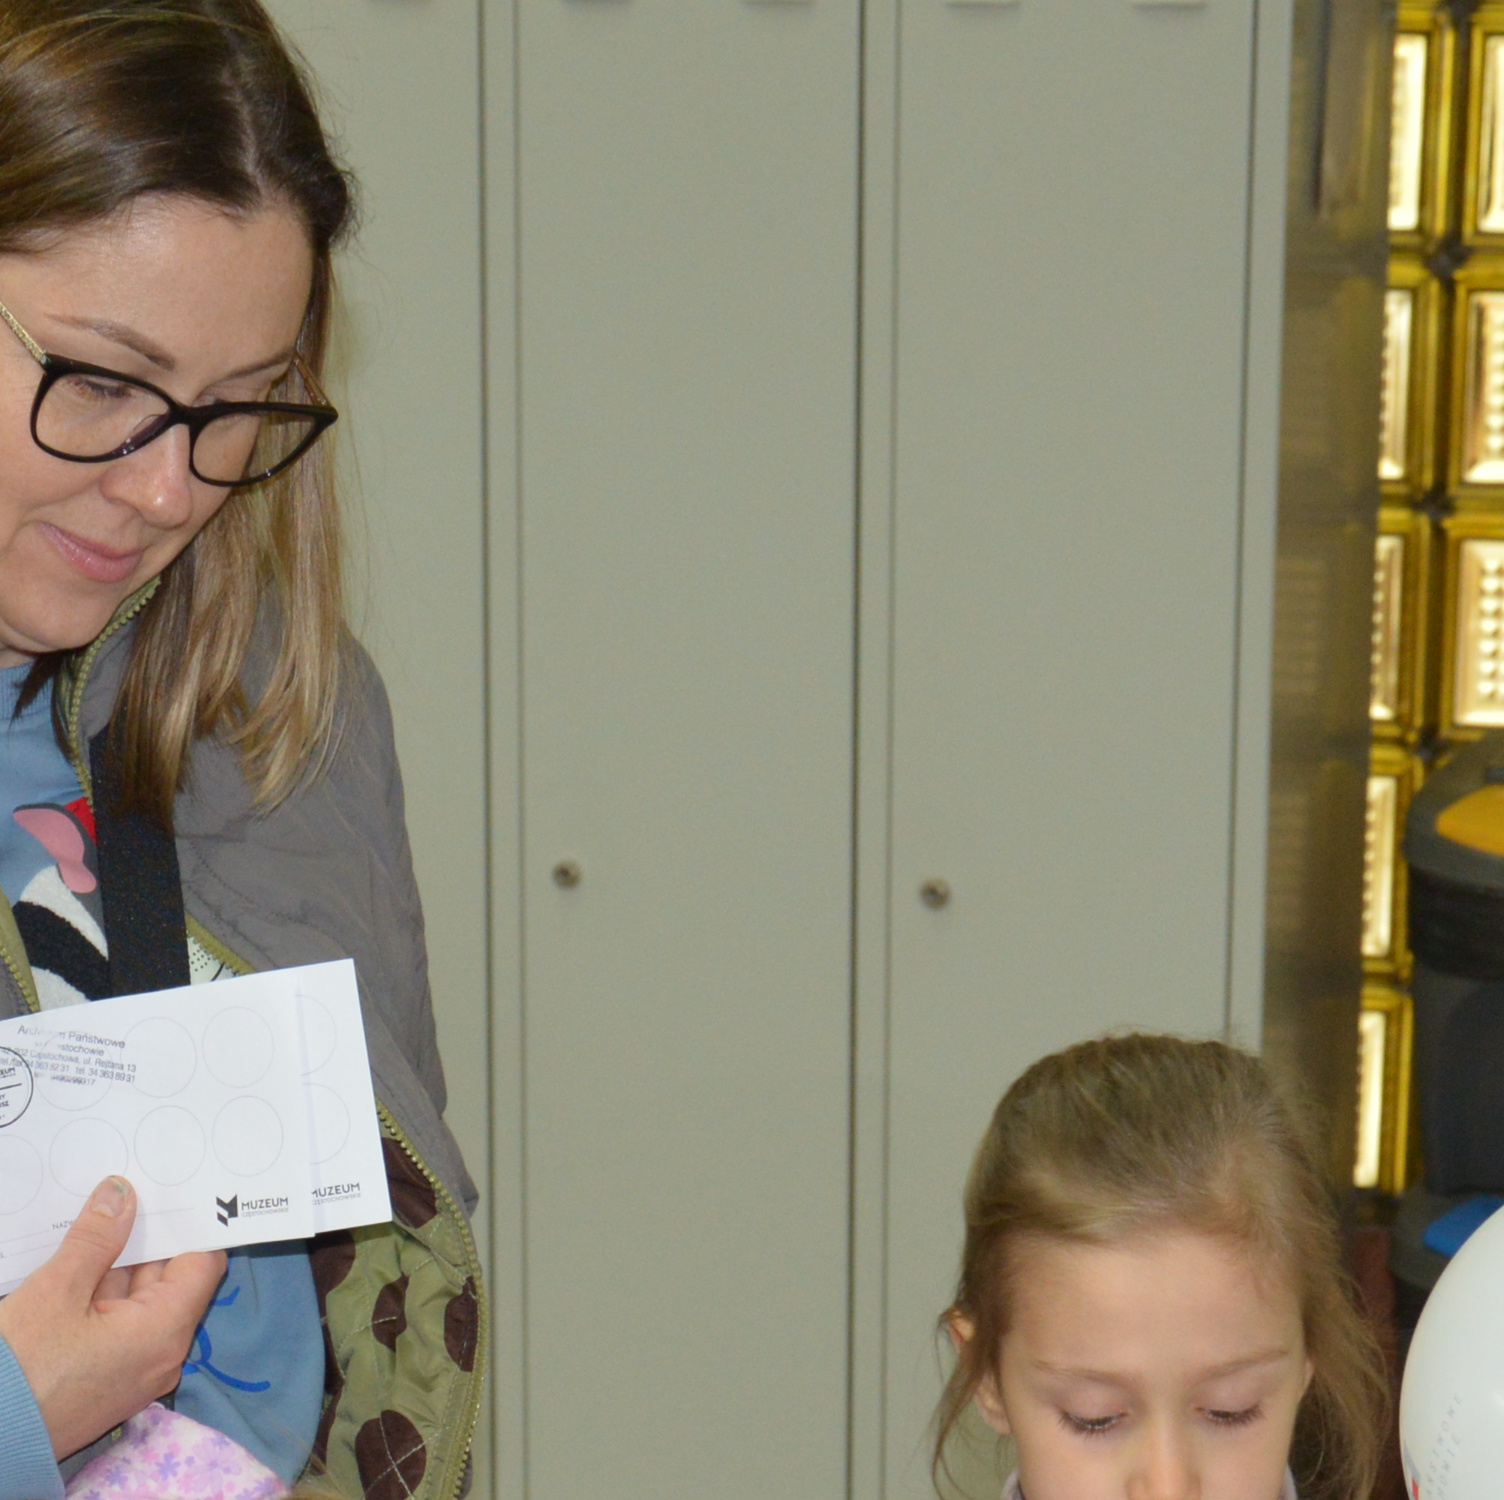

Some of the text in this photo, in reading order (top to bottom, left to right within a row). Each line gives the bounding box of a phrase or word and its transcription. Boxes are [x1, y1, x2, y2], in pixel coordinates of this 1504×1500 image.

[68, 1031, 126, 1049] Państwowe
[94, 1057, 125, 1071] Rejtana
[127, 1063, 137, 1073] 13
[88, 1067, 99, 1077] 34
[241, 1197, 289, 1211] MUZEUM
[241, 1207, 289, 1219] CZĘSTOCHOWSKIE
[52, 1218, 78, 1231] NAZW
